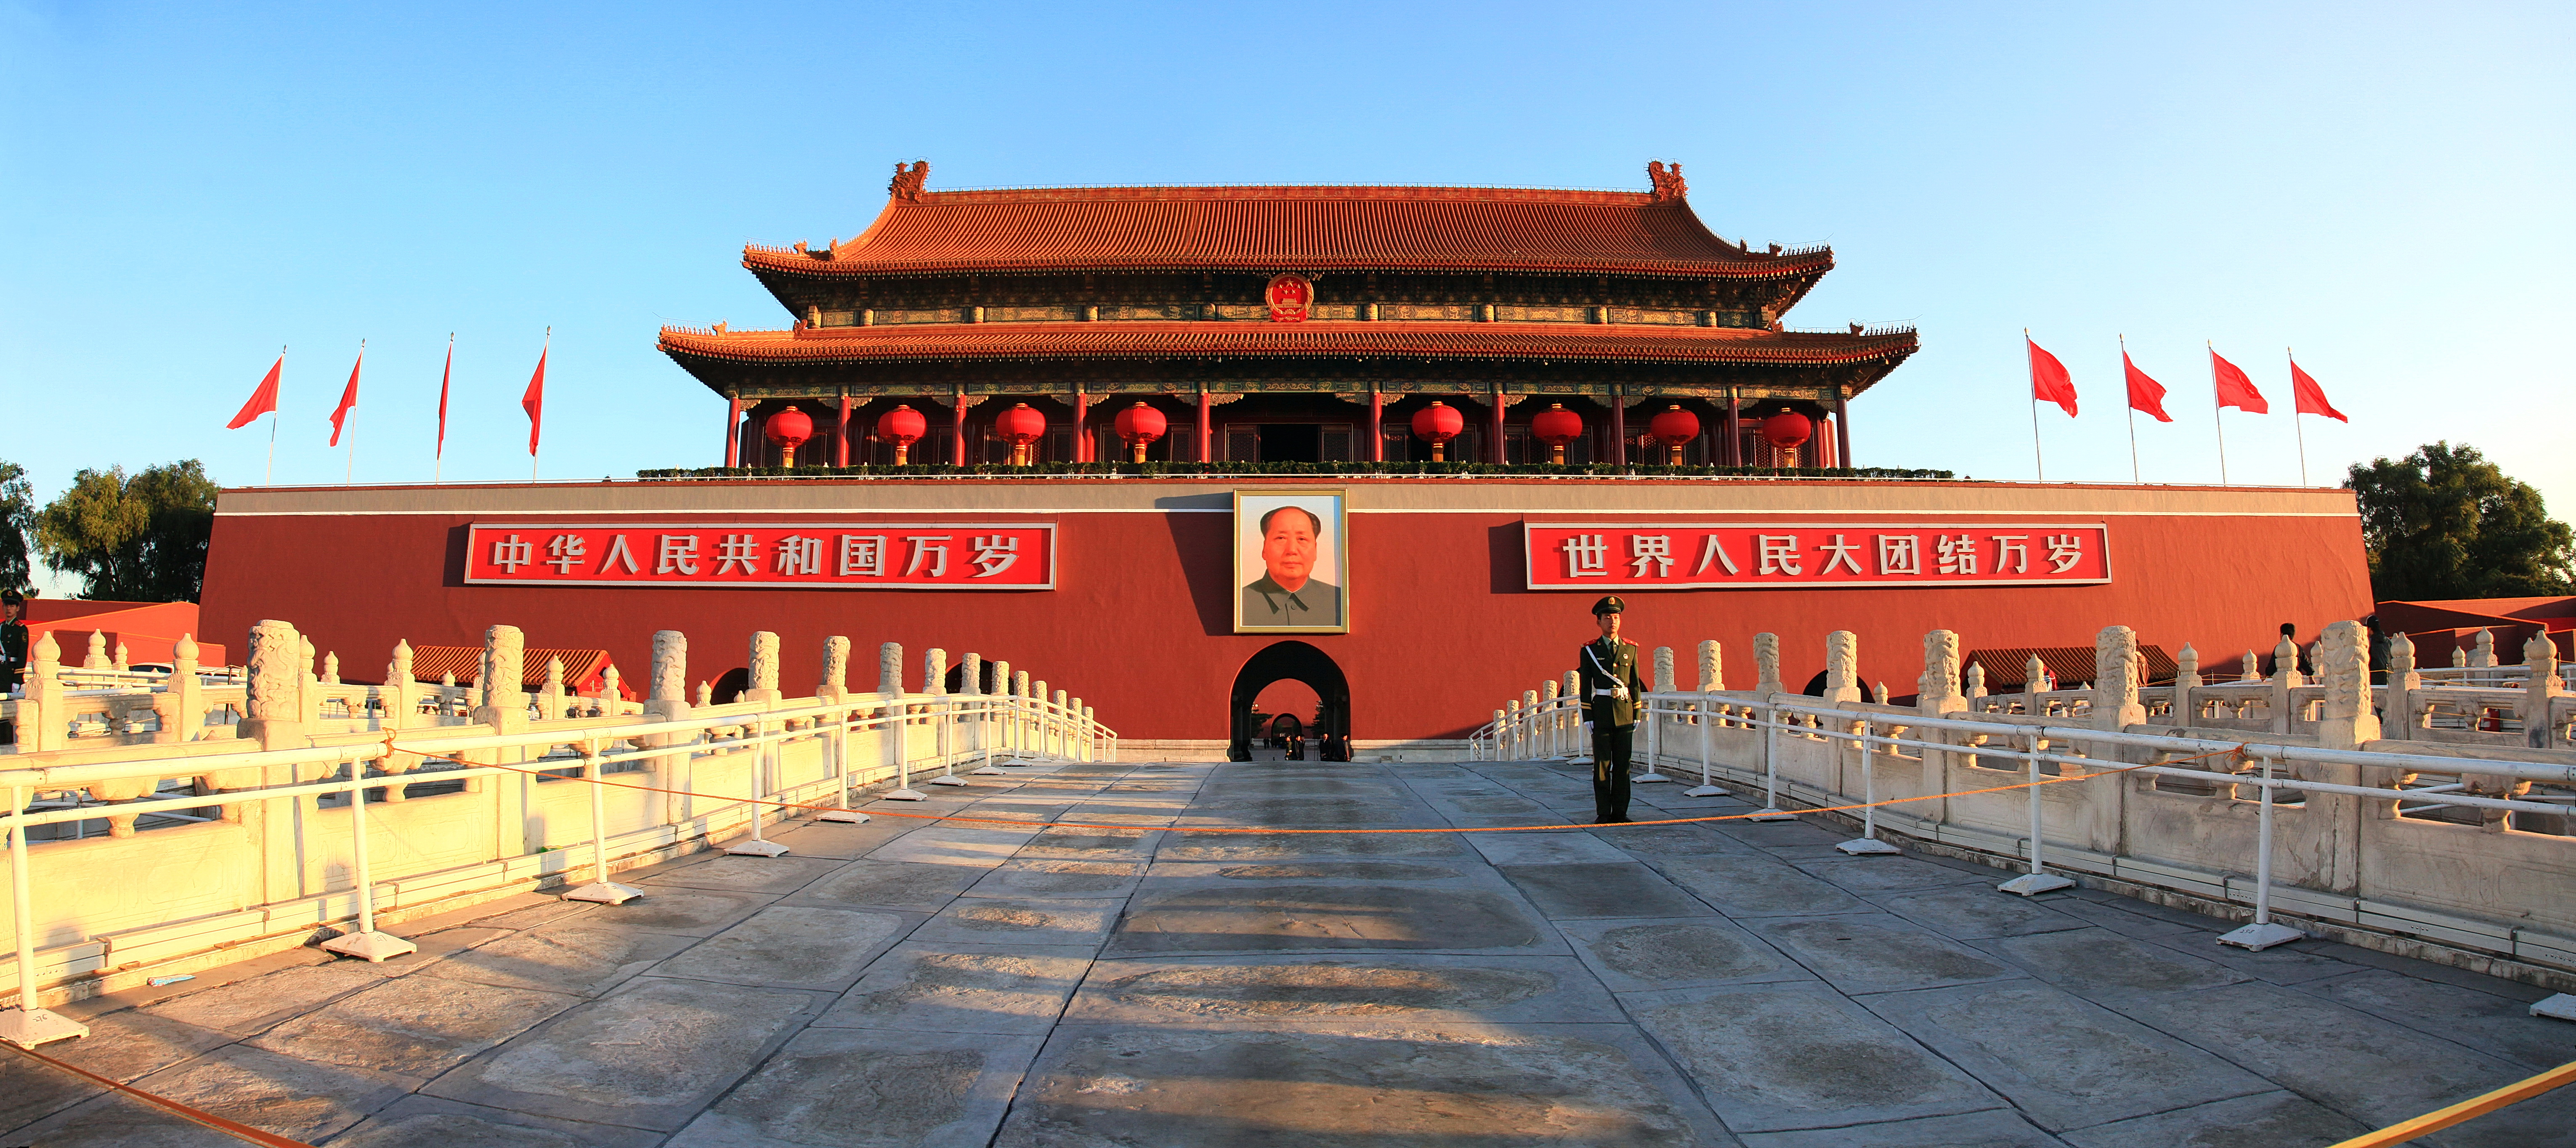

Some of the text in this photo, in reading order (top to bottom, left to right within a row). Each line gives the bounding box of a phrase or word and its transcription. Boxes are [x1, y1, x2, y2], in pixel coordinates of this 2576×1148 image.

[494, 534, 1020, 578] 中华人民共和国万岁
[1562, 533, 2083, 578] 世界人民大团结万岁
